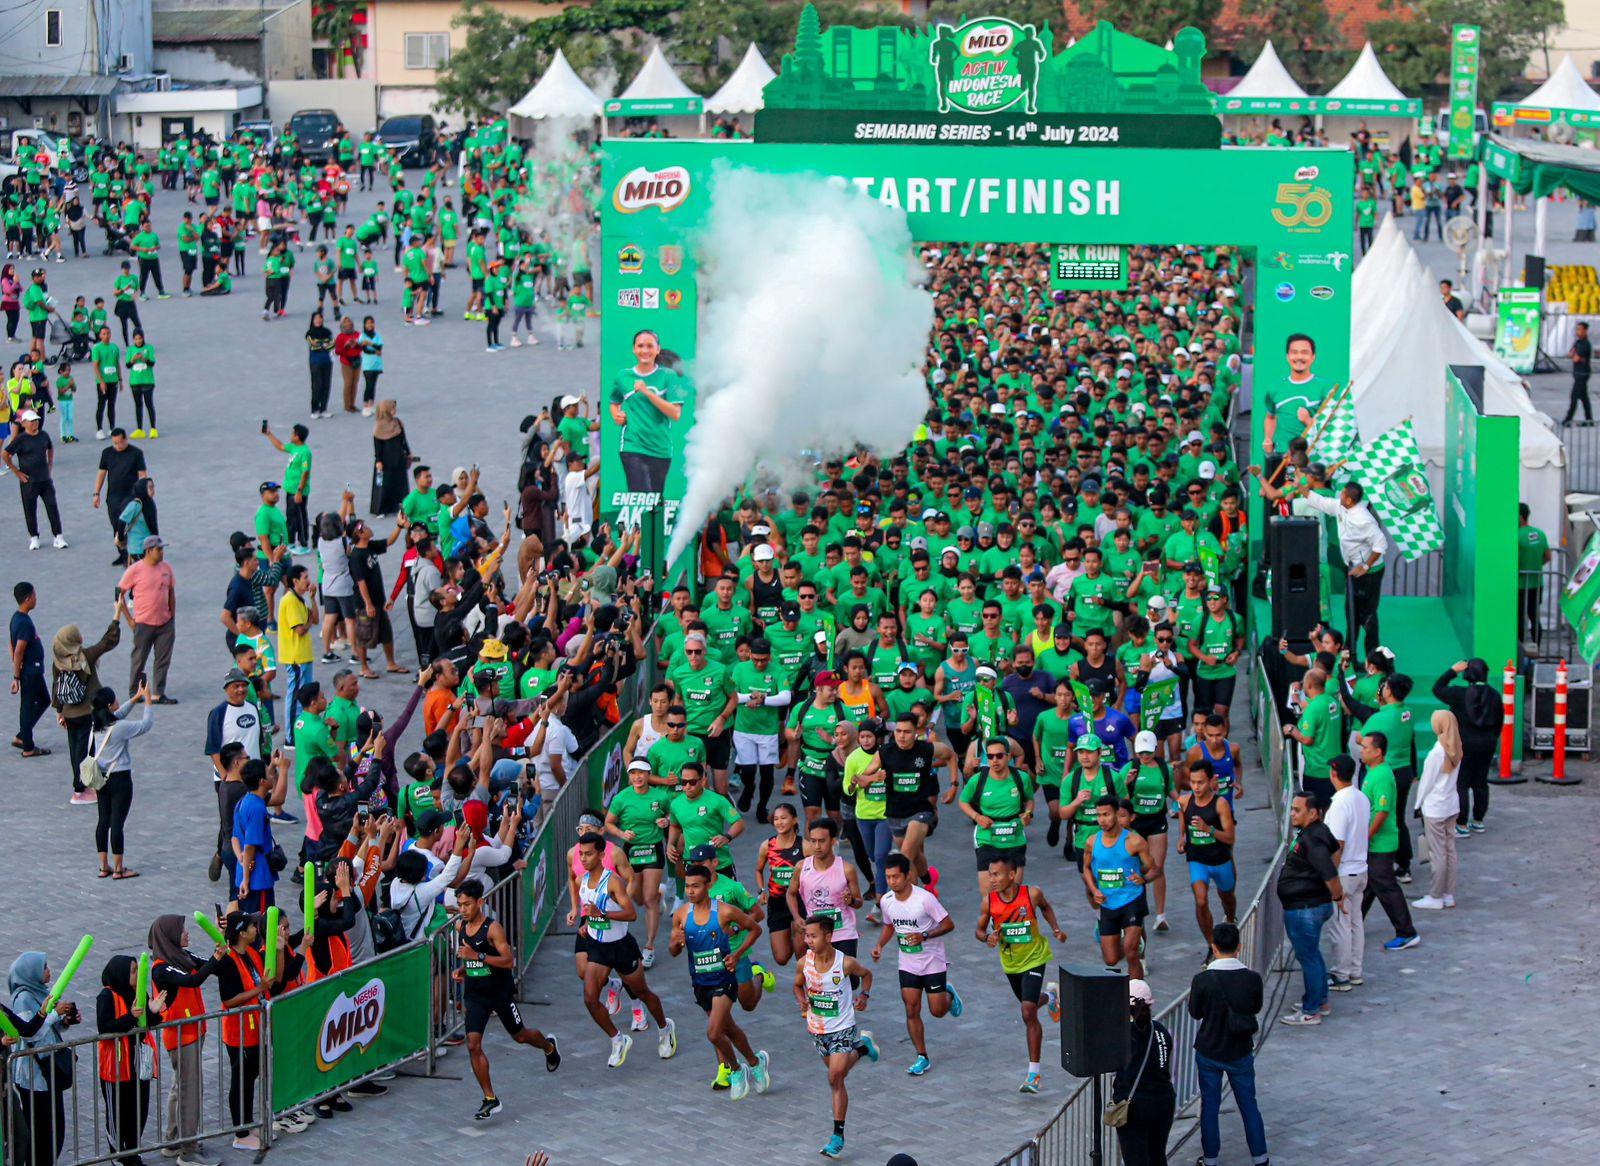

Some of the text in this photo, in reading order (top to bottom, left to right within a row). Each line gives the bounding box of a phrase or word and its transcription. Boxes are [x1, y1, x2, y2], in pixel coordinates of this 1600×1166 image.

[968, 34, 1008, 49] MILO
[961, 60, 1008, 76] ACTIV
[948, 74, 1022, 93] INDONESIA
[967, 89, 1003, 107] RACE
[854, 123, 937, 139] SEMARANG
[939, 124, 991, 140] SERIES
[1006, 122, 1037, 140] 14th
[1040, 125, 1075, 145] July
[1078, 126, 1119, 142] 2024
[624, 180, 682, 202] MILO
[852, 176, 1120, 218] TART/FINISH
[1271, 183, 1332, 227] 50
[1058, 245, 1120, 261] 5K RUN
[611, 491, 661, 506] ENERGI
[1145, 705, 1162, 716] PACE
[1147, 715, 1155, 729] 6
[984, 725, 991, 738] 6
[353, 984, 378, 1007] Nestlé
[326, 998, 379, 1054] MILO
